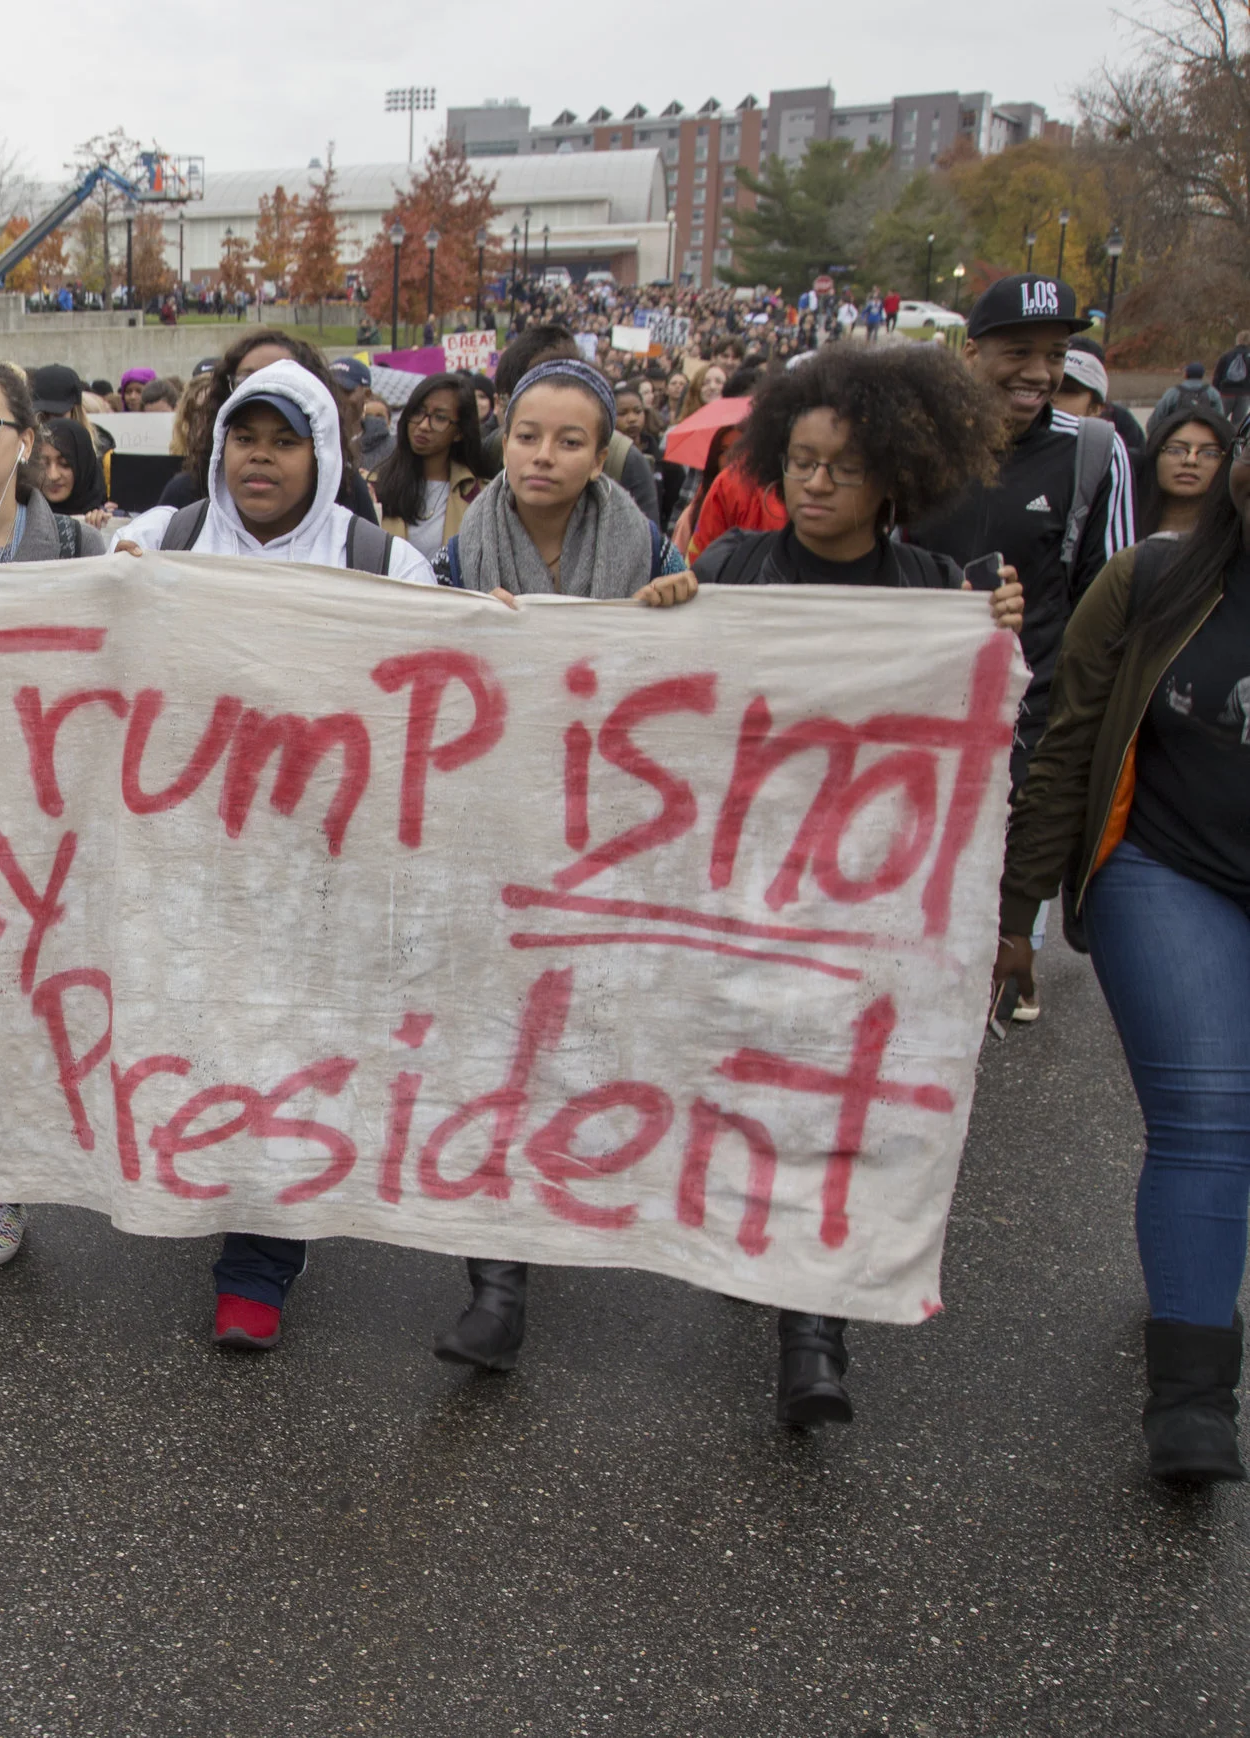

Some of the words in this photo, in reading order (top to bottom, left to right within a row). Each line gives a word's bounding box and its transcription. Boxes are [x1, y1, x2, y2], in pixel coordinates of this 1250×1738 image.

[1021, 281, 1058, 309] LOS
[711, 628, 1017, 938] not
[33, 966, 955, 1257] President
